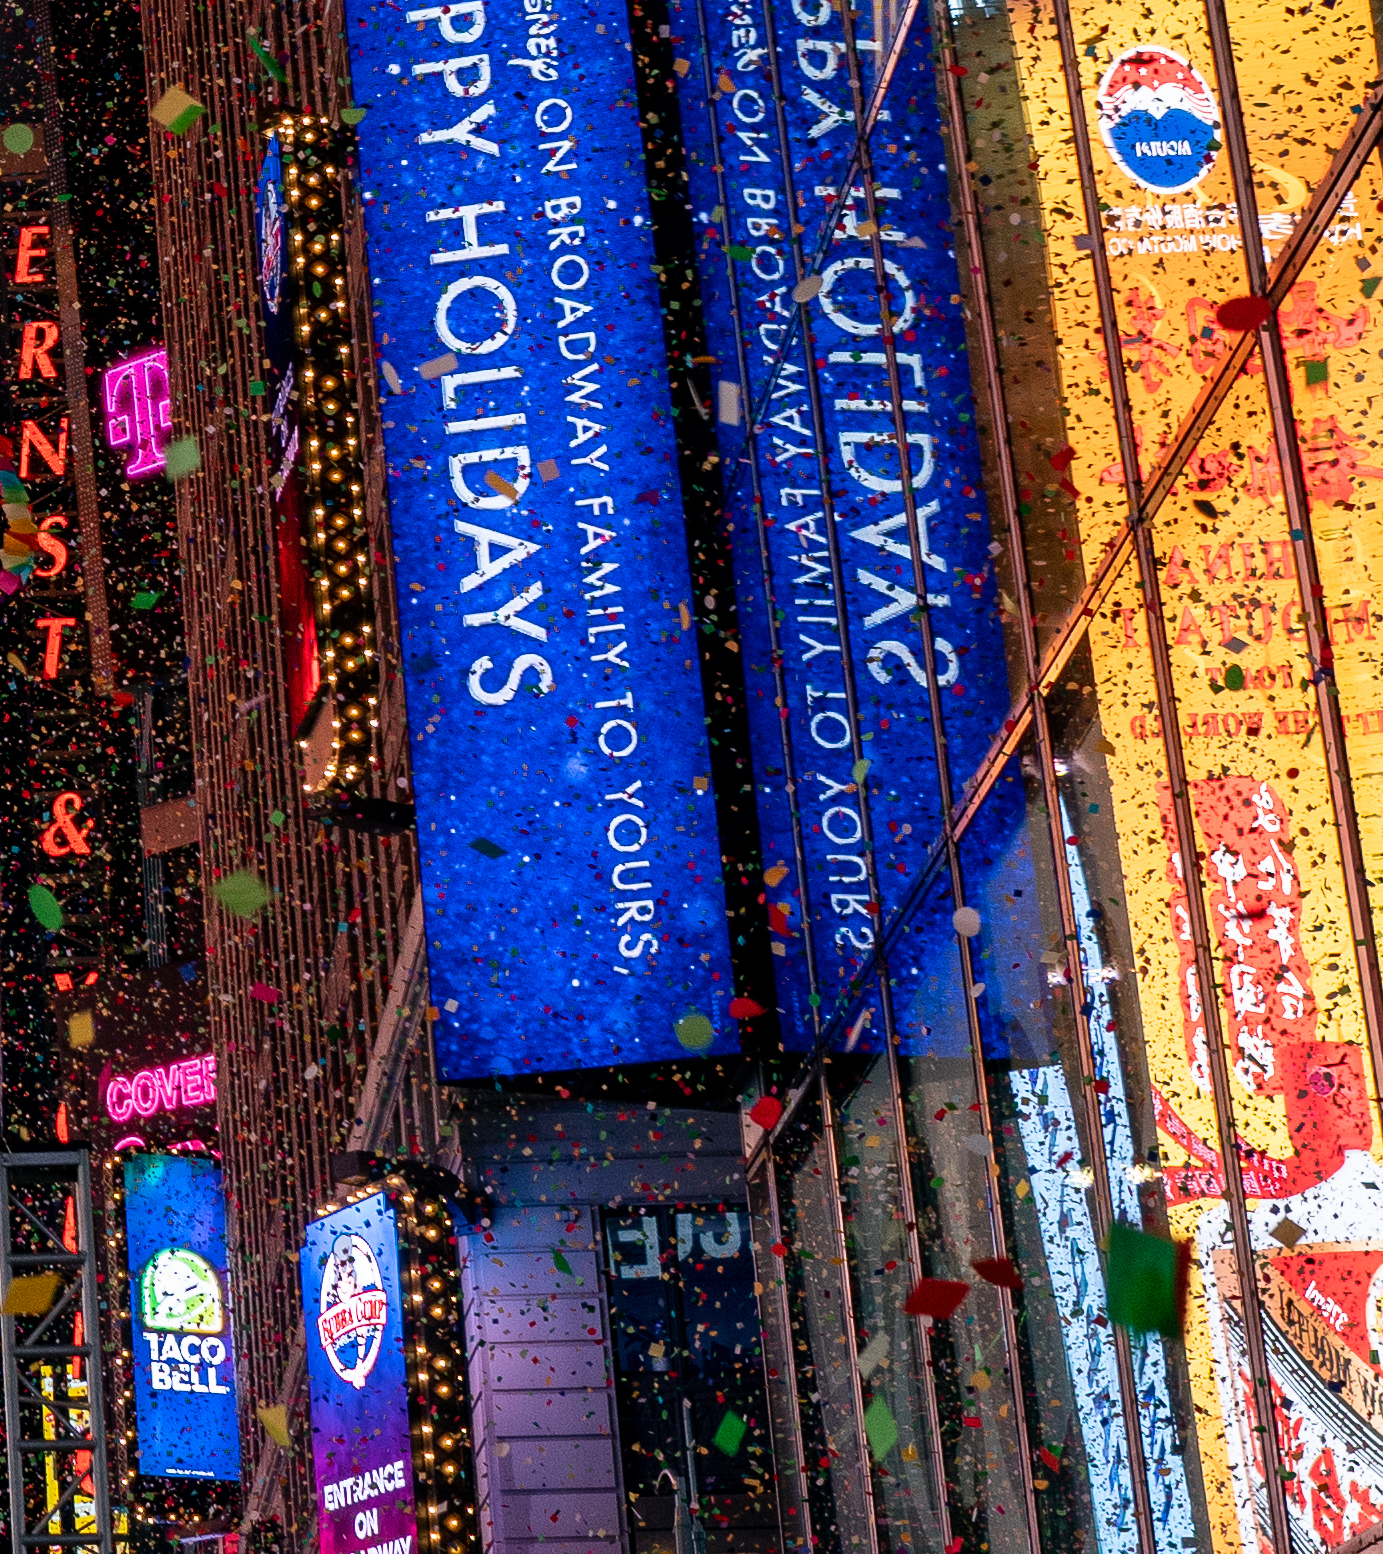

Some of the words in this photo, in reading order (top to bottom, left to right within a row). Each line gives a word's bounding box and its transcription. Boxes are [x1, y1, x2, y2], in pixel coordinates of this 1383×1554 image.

[535, 97, 578, 179] ON
[544, 196, 610, 472] BROADWAY
[14, 226, 75, 681] ERNST
[425, 199, 555, 706] HOLIDAYS
[575, 494, 630, 667] FAMILY
[594, 691, 638, 758] TO
[42, 792, 95, 856] &
[143, 1332, 226, 1365] TACO
[151, 1362, 229, 1394] BELL
[323, 1460, 405, 1511] ENTRANCE
[355, 1507, 379, 1540] ON
